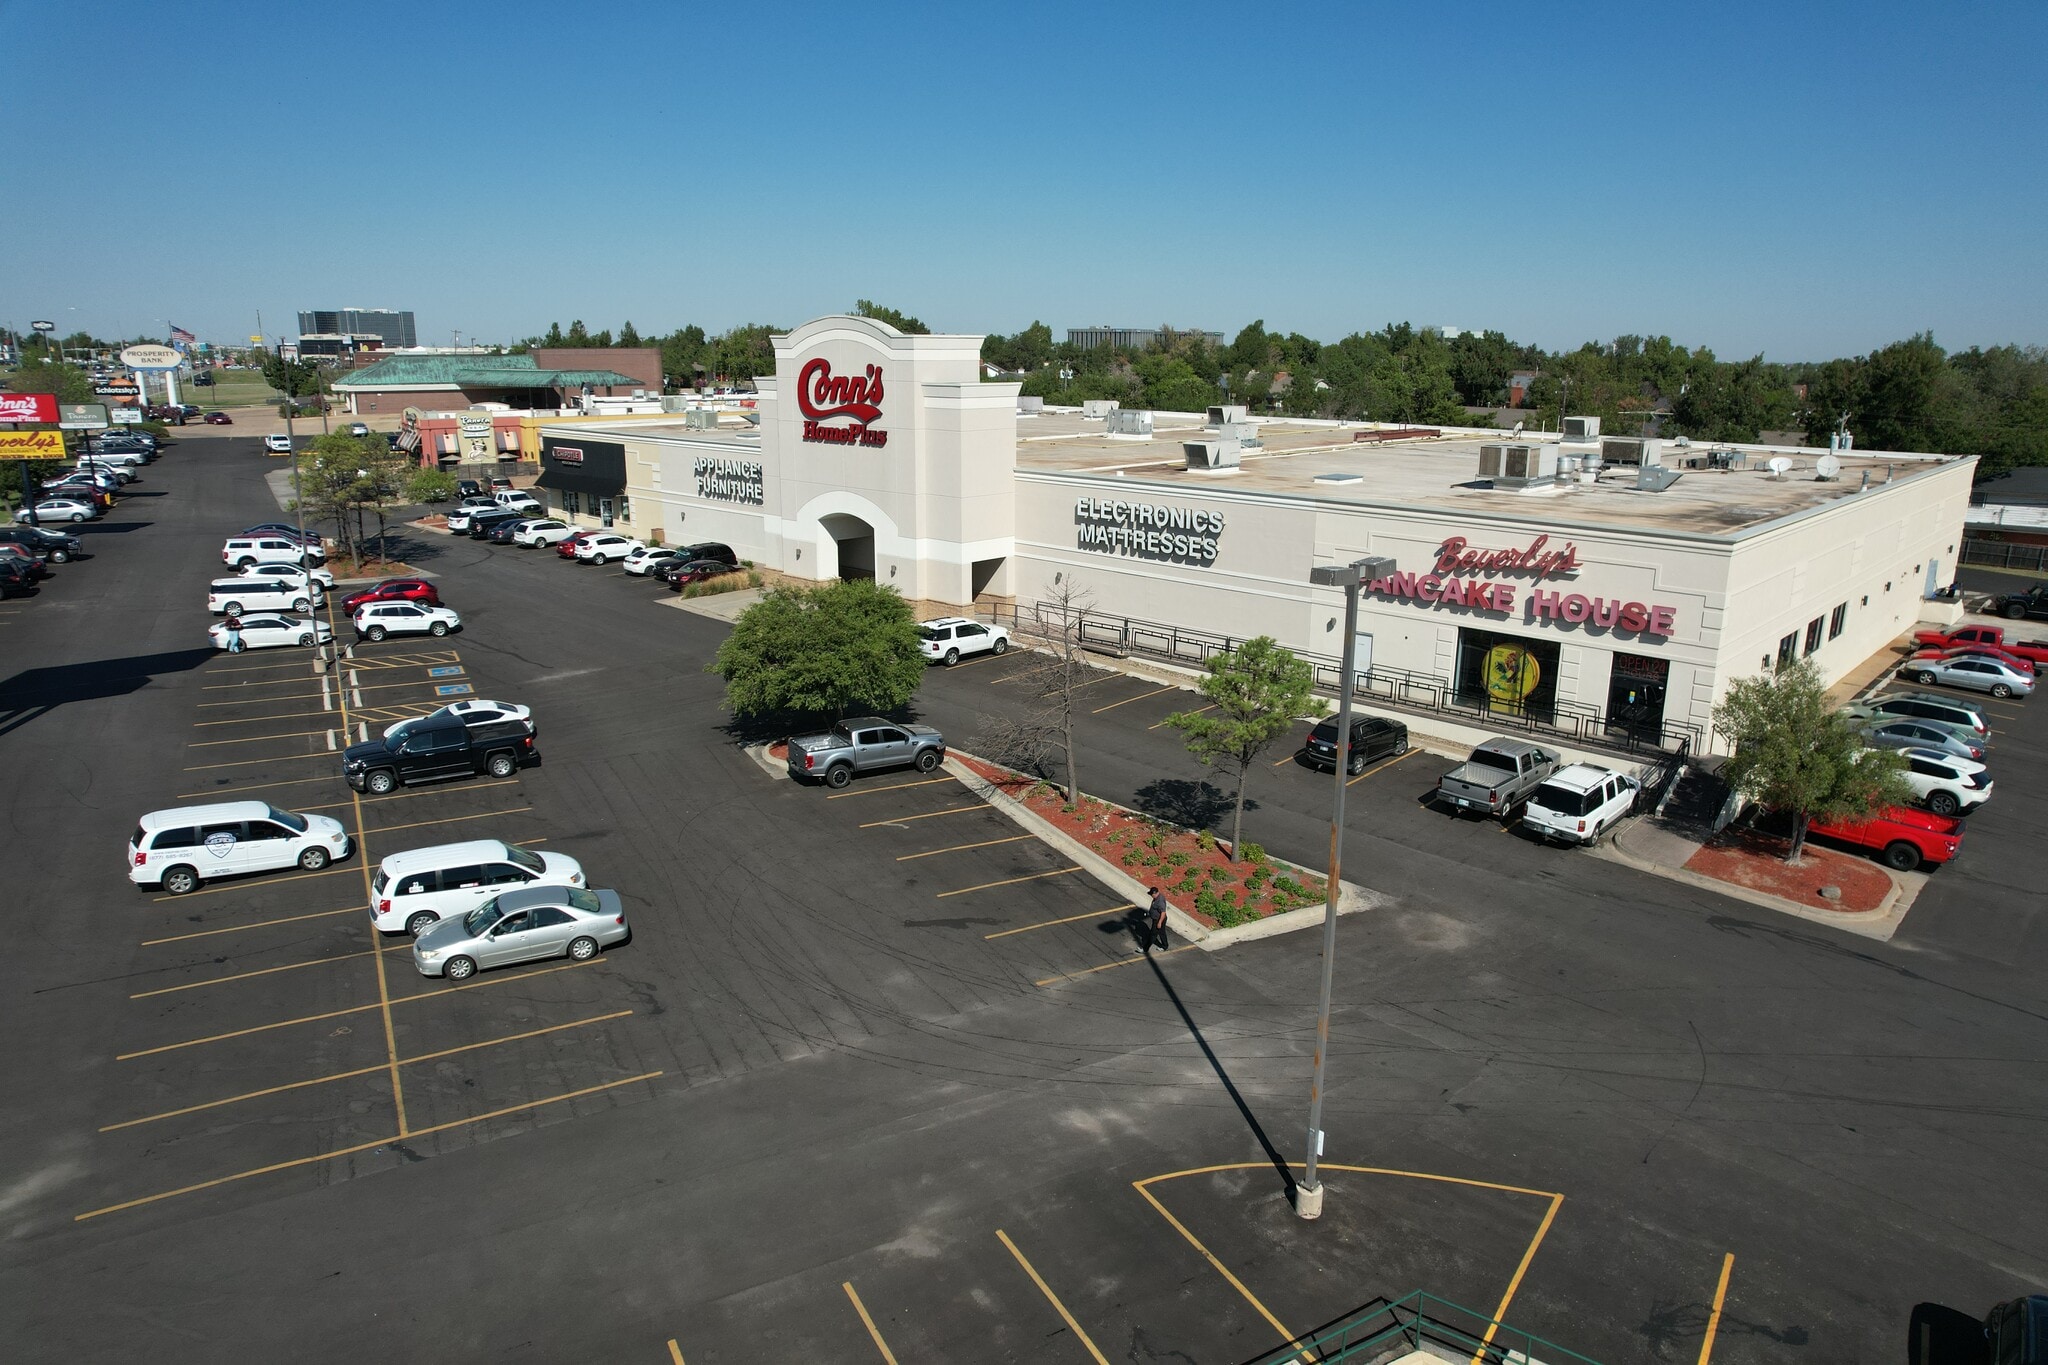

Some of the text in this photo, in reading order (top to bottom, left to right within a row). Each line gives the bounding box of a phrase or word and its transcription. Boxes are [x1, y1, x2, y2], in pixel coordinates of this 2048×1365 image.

[95, 387, 138, 395] Schlotzsky's
[798, 357, 884, 424] Conn's
[803, 421, 887, 446] HomePlus
[557, 450, 580, 460] CHIPOTLE
[696, 475, 763, 499] FURNITURE
[1077, 496, 1224, 534] ELECTRONICS
[1080, 523, 1218, 560] MATTRESSES
[1436, 534, 1583, 577] Beverly's
[1359, 570, 1677, 636] ANCAKE HOUSE
[1619, 655, 1667, 673] OPEN 24
[1623, 670, 1660, 680] HOURS
